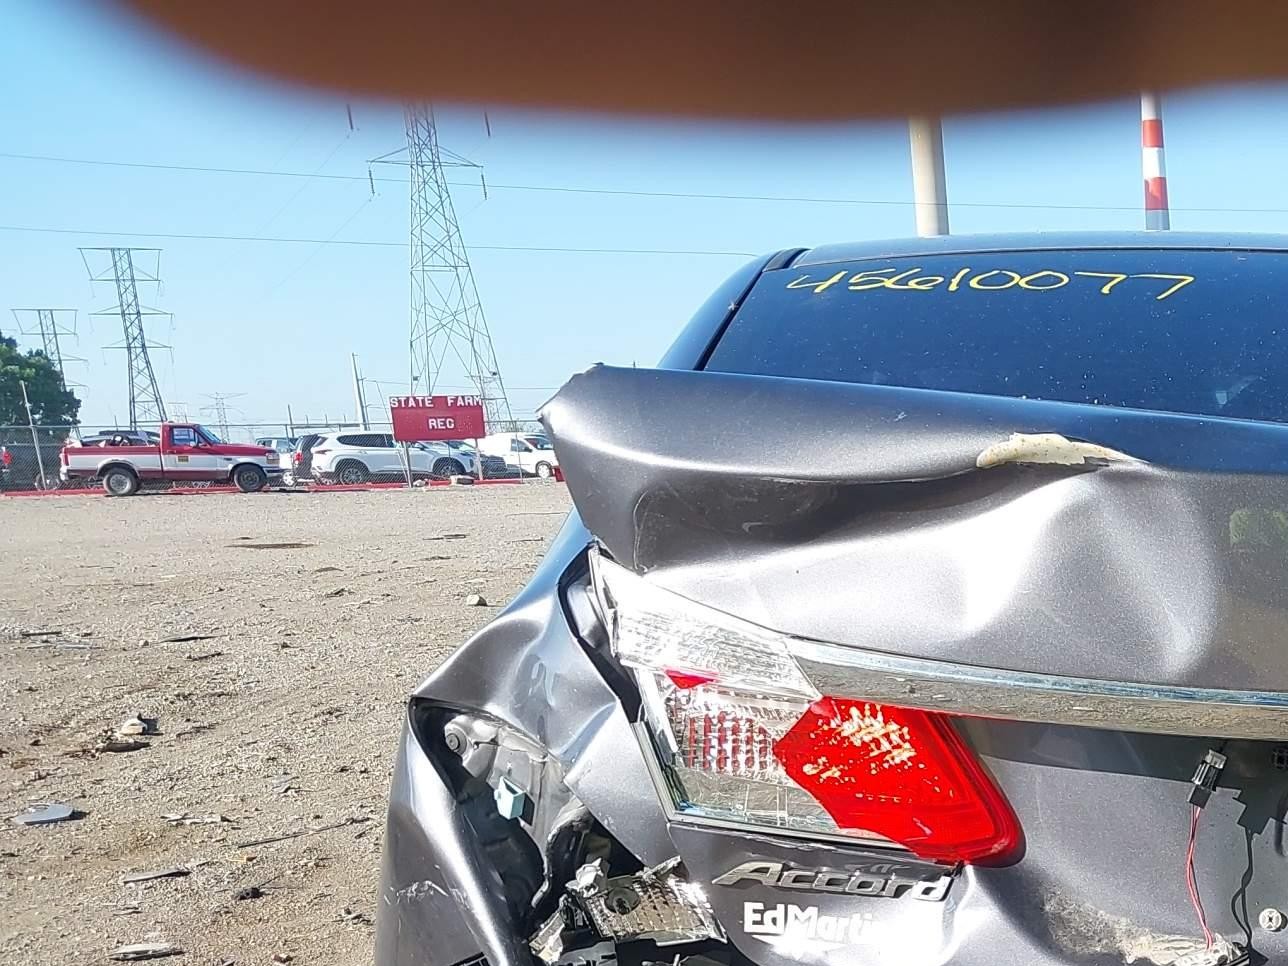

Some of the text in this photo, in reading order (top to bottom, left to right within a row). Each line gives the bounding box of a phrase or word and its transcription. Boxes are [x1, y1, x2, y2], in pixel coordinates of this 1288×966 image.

[786, 267, 1195, 300] 45610077
[390, 395, 482, 408] STATE FARM
[428, 418, 455, 429] REC
[712, 861, 952, 901] Accord
